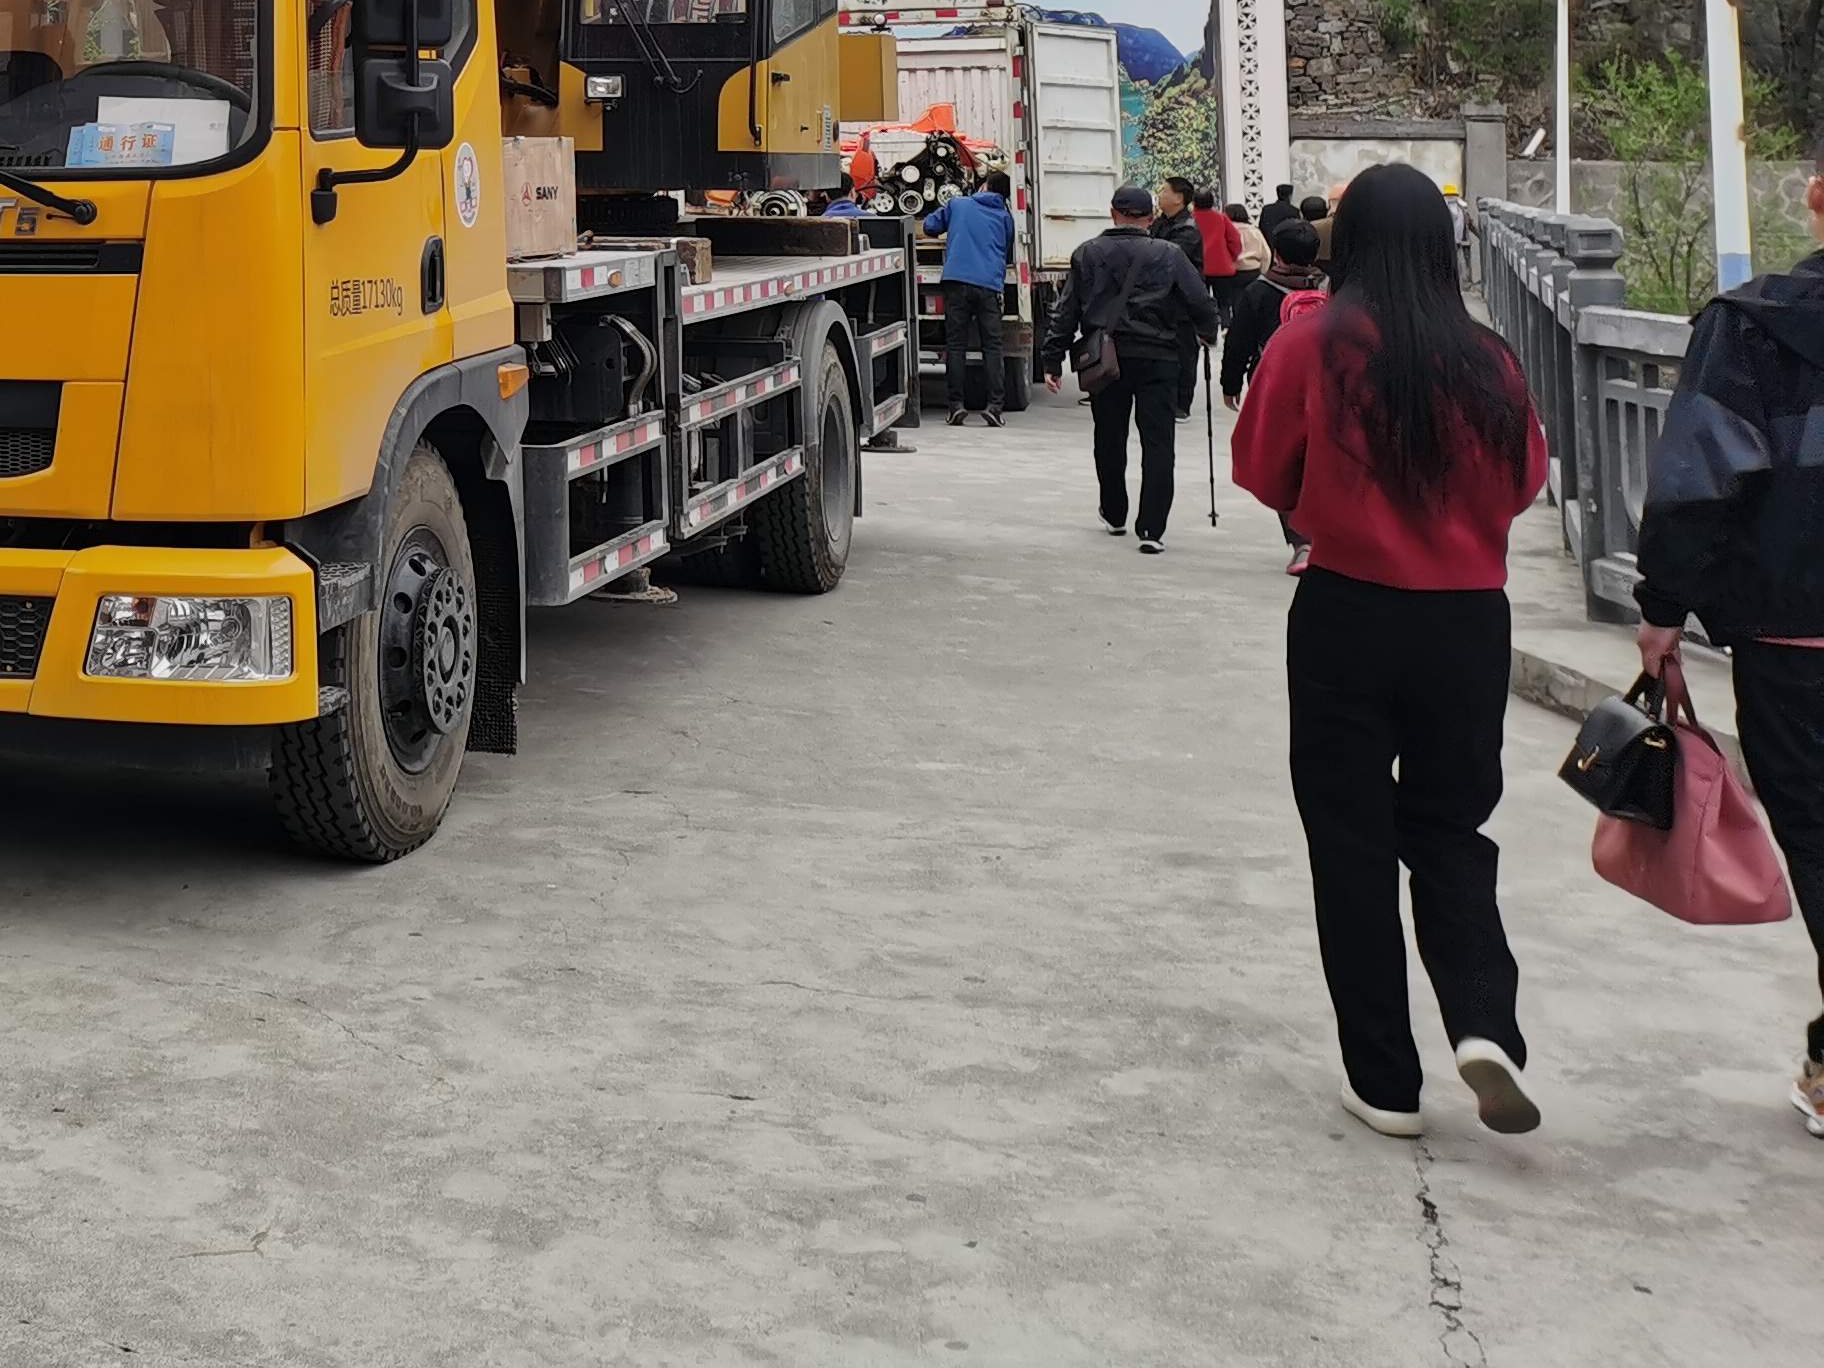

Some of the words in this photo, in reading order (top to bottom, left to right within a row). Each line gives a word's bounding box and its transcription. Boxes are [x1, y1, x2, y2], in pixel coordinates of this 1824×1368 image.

[98, 133, 158, 152] 通行证
[536, 186, 558, 200] SANY
[330, 278, 403, 316] 总质量17130kg
